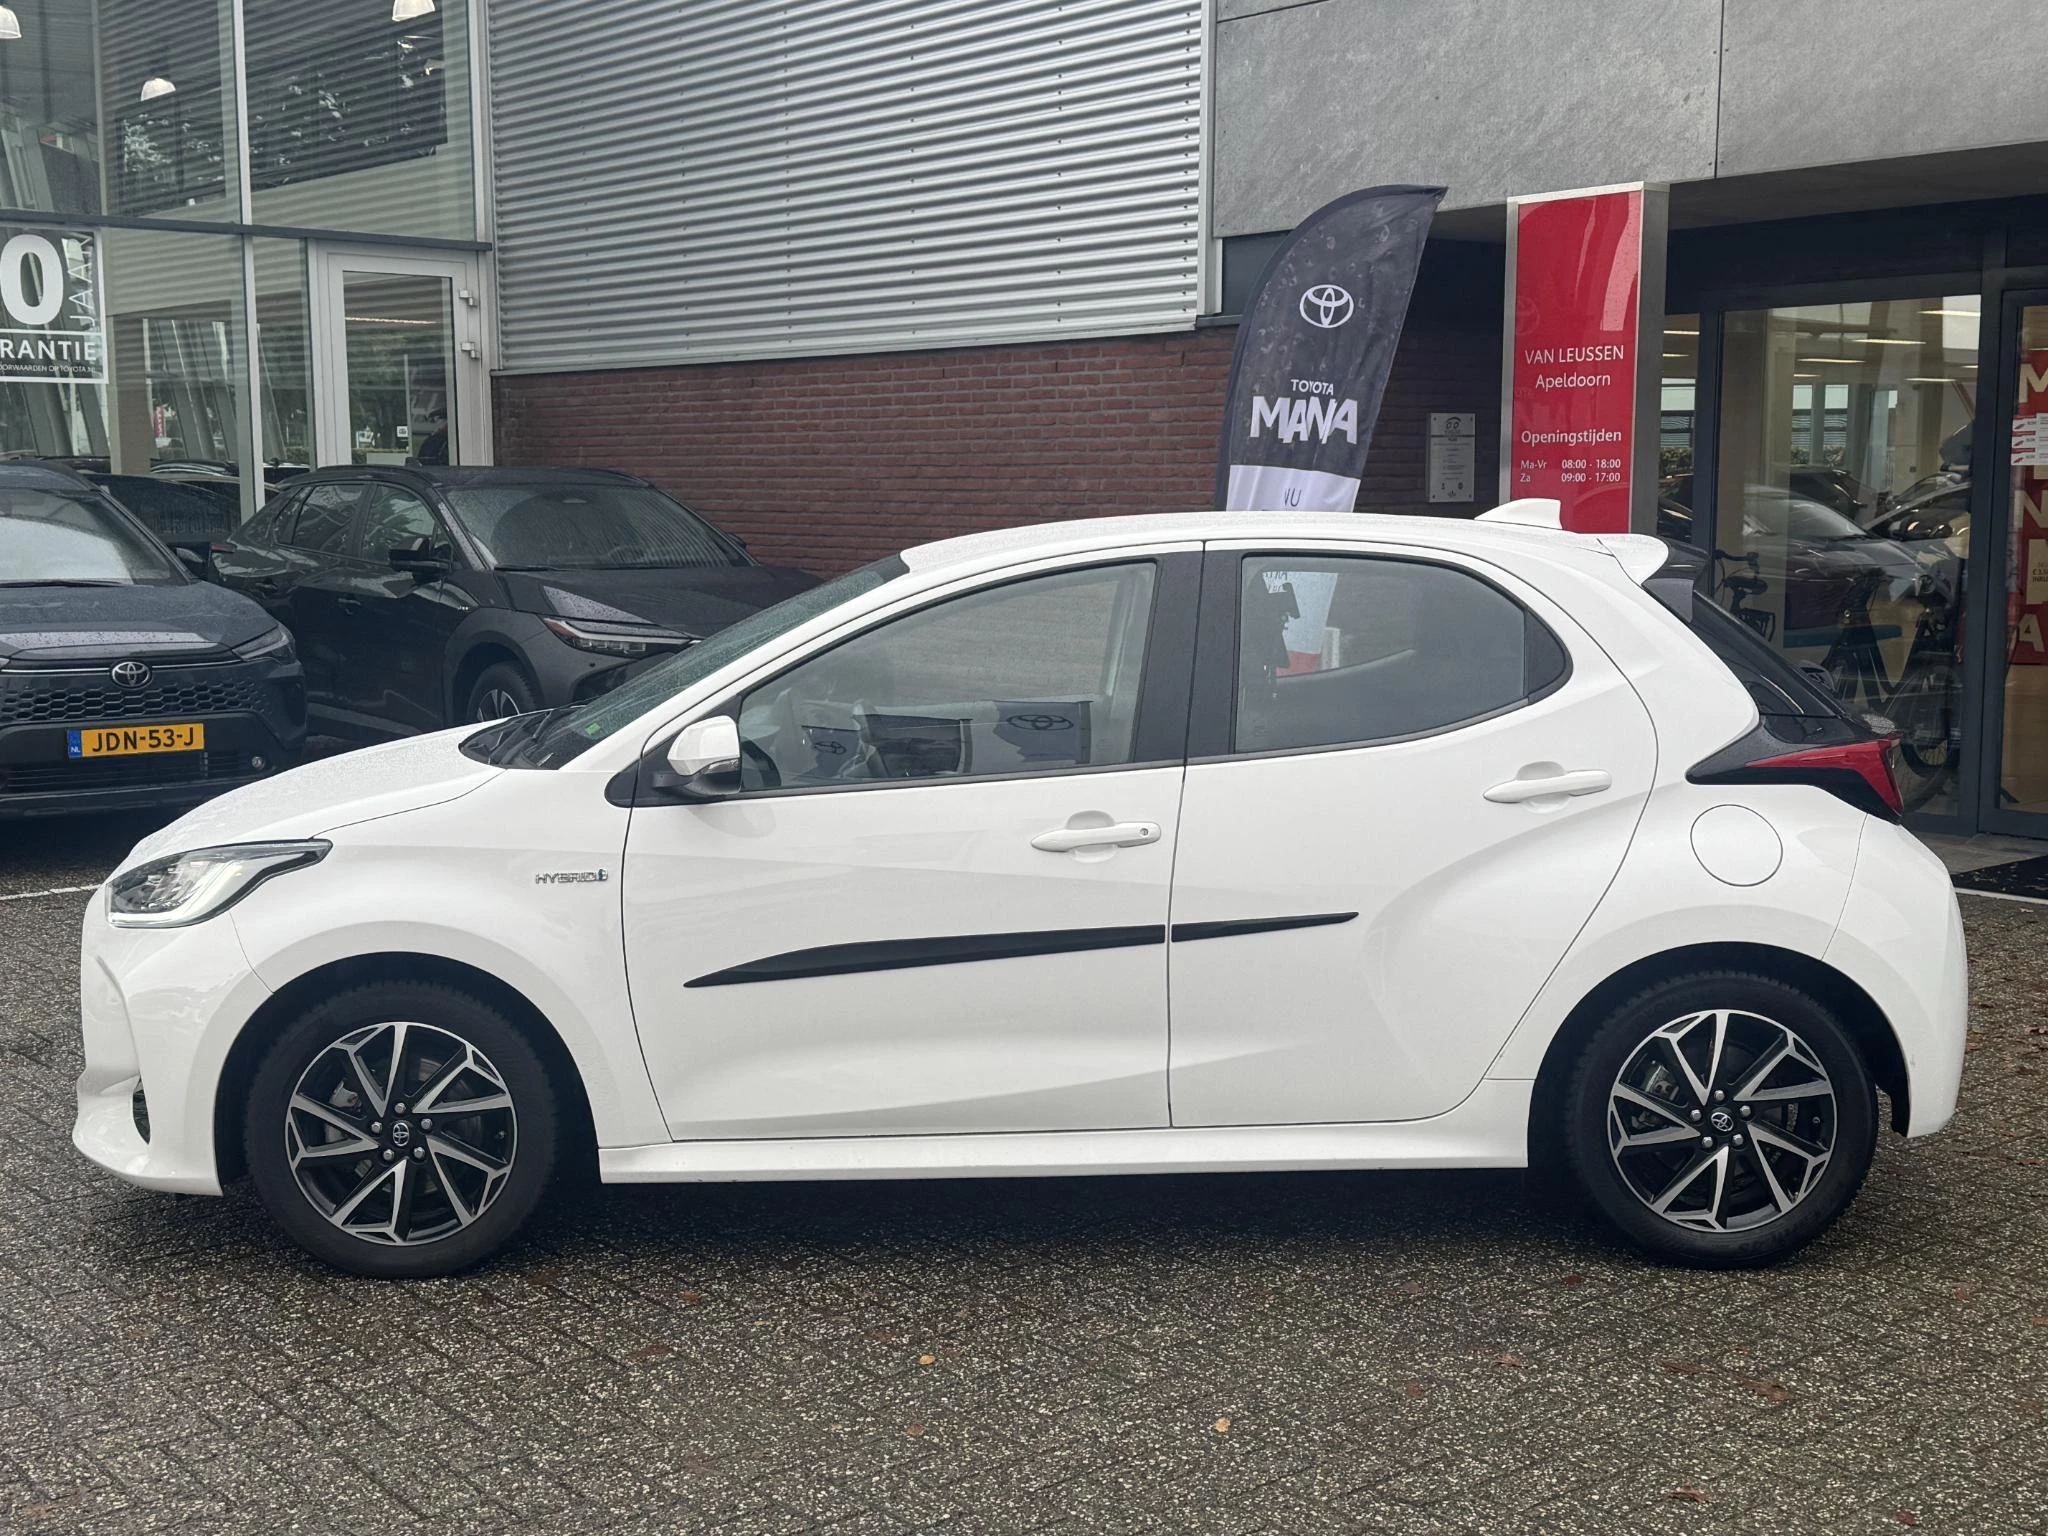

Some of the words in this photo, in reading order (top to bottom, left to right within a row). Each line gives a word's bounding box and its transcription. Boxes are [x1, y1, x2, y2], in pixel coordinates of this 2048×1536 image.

[0, 338, 97, 361] RANTIE
[1524, 349, 1554, 364] VAN
[1558, 344, 1625, 363] LEUSSEN
[1291, 379, 1334, 396] TOYOTA
[1535, 371, 1611, 392] Apeldoorn
[1521, 428, 1622, 447] Openingstijden
[1520, 459, 1547, 470] Ma-Vr
[1561, 459, 1587, 469] 08:00
[1596, 458, 1621, 469] 18:00
[1519, 474, 1531, 483] Za
[1561, 473, 1587, 483] 09:00
[1595, 472, 1621, 482] 17:00
[70, 745, 81, 753] NL
[92, 727, 195, 753] JDN-53-J
[535, 871, 598, 885] HYBRID
